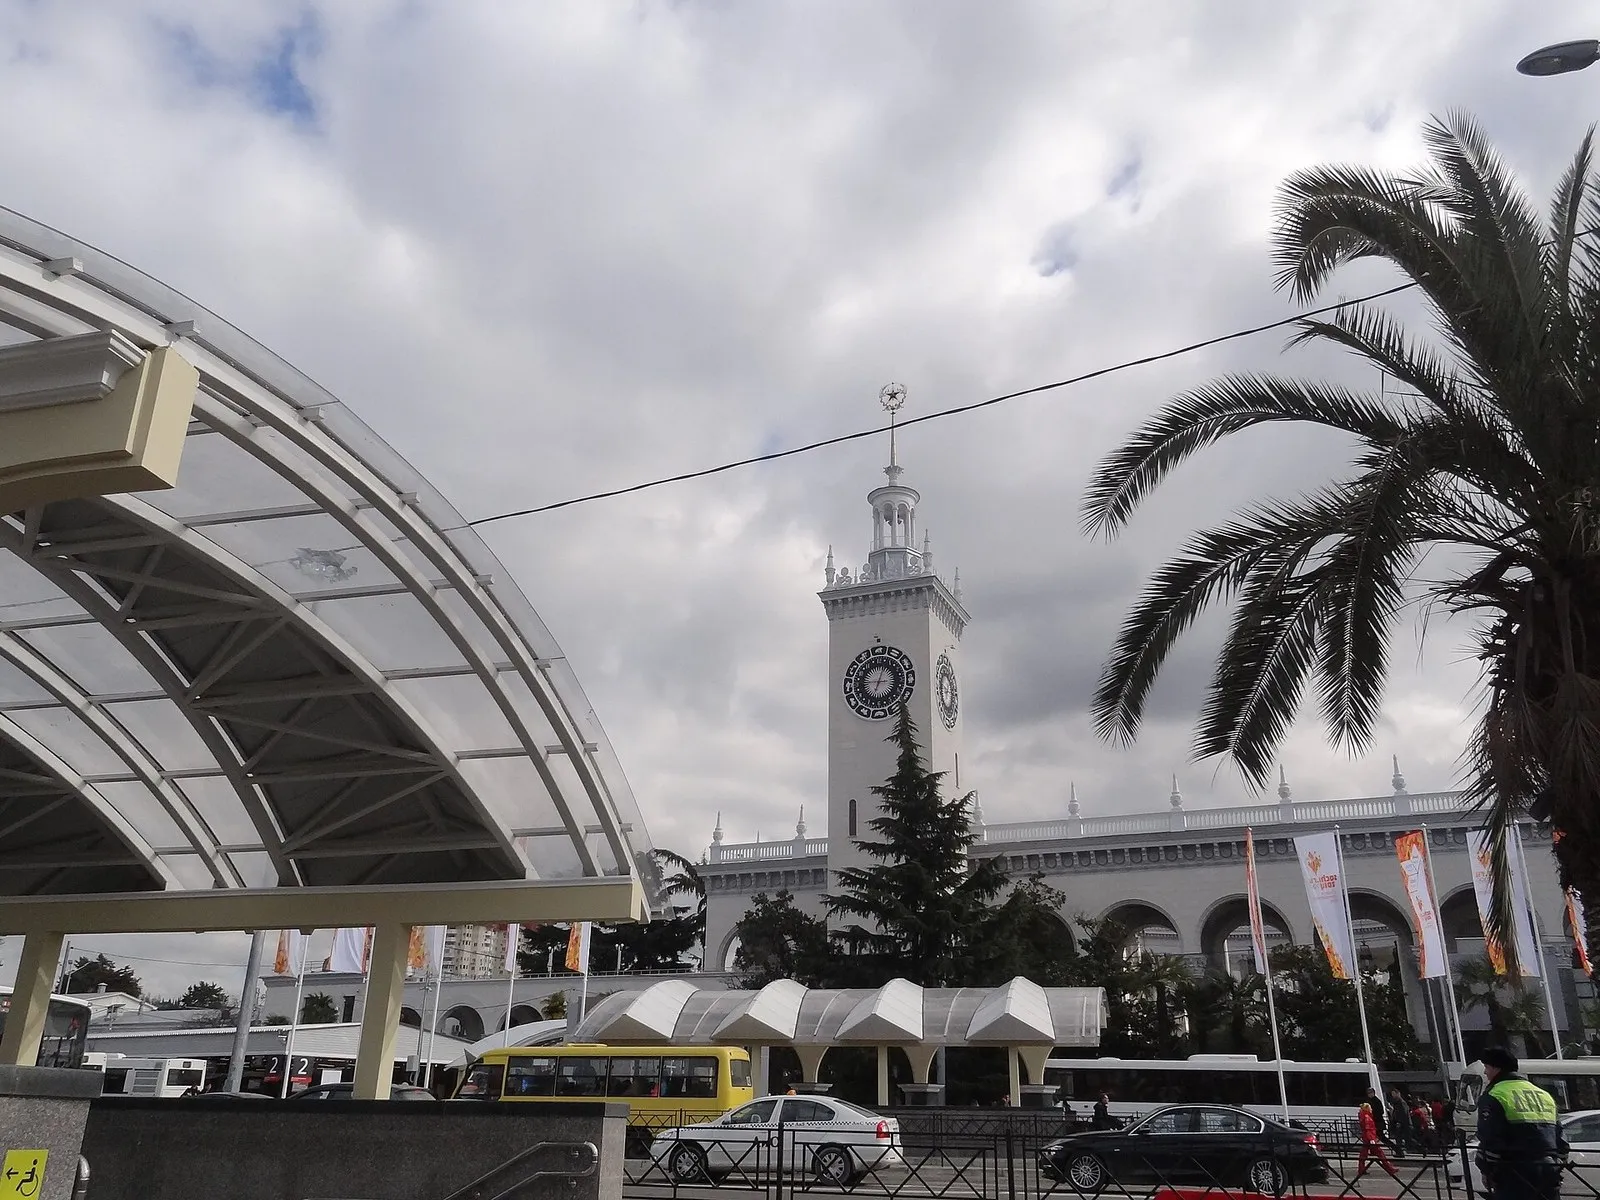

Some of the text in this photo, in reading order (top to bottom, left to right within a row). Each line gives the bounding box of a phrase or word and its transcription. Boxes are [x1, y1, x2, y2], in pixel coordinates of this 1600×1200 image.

[269, 1056, 279, 1074] 2
[297, 1058, 309, 1075] 2
[1511, 1088, 1552, 1113] ДПС
